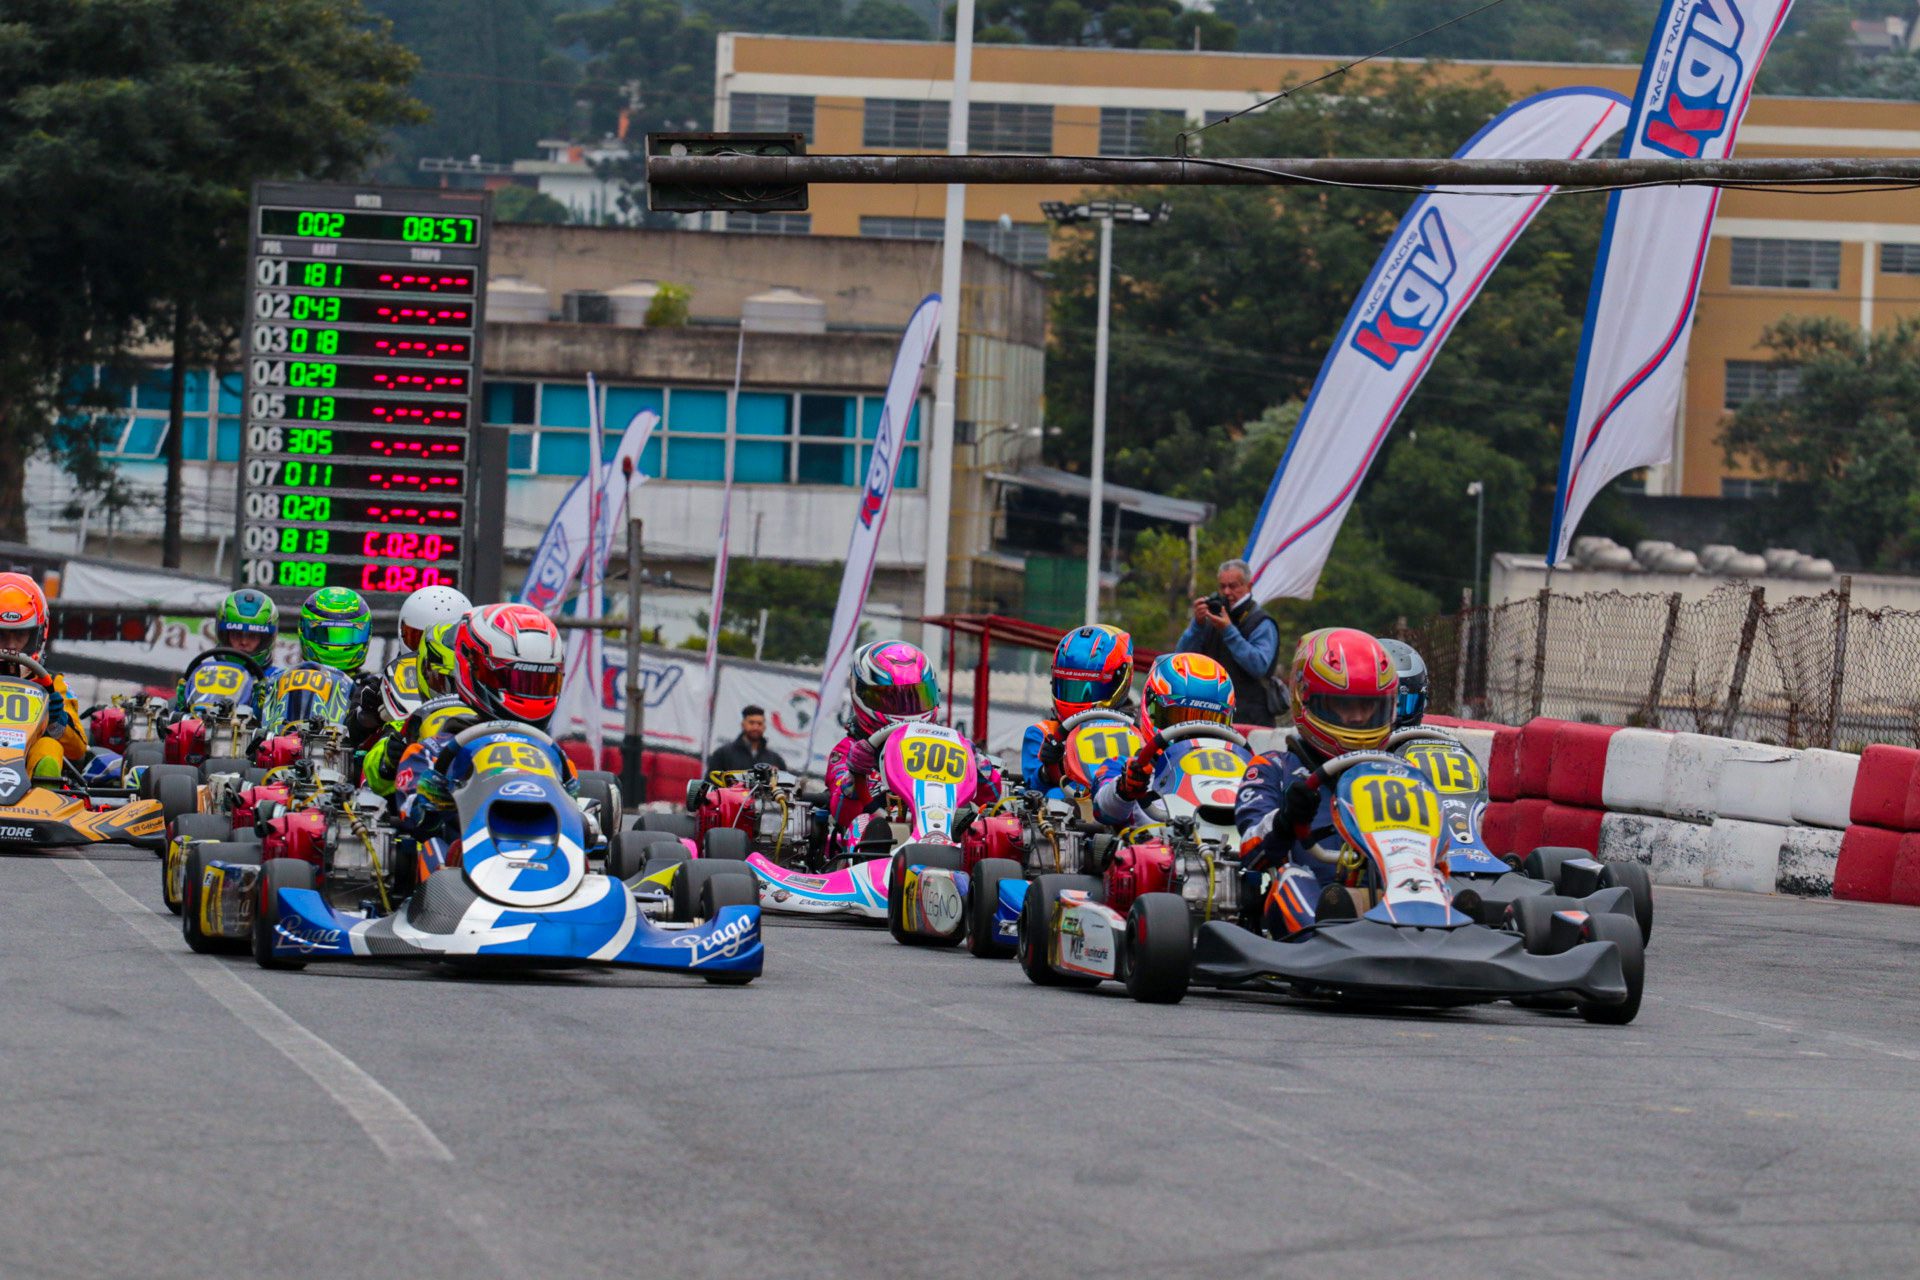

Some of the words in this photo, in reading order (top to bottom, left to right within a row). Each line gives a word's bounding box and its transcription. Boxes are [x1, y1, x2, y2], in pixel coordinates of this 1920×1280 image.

[298, 211, 345, 238] 002
[403, 216, 473, 242] 08:57
[257, 260, 288, 286] 01
[304, 263, 342, 287] 181
[256, 292, 290, 319] 02
[292, 296, 340, 321] 043
[254, 326, 288, 353] 03
[291, 328, 339, 354] 018
[253, 360, 286, 386] 04
[289, 362, 337, 388] 029
[252, 393, 285, 419] 05
[297, 396, 335, 421] 113
[250, 426, 283, 452] 06
[287, 429, 333, 454] 305
[248, 460, 281, 486] 07
[284, 461, 332, 487] 011
[246, 494, 279, 519] 08
[282, 495, 330, 521] 020
[244, 527, 279, 552] 09
[281, 528, 329, 554] 813
[243, 559, 274, 584] 10
[279, 561, 327, 587] 088
[197, 668, 239, 691] 33
[488, 745, 547, 770] 43
[1083, 731, 1131, 760] 11
[906, 742, 966, 778] 305
[1193, 751, 1237, 772] 18
[1413, 752, 1475, 790] 113
[1363, 779, 1431, 828] 181
[672, 914, 758, 968] Praga
